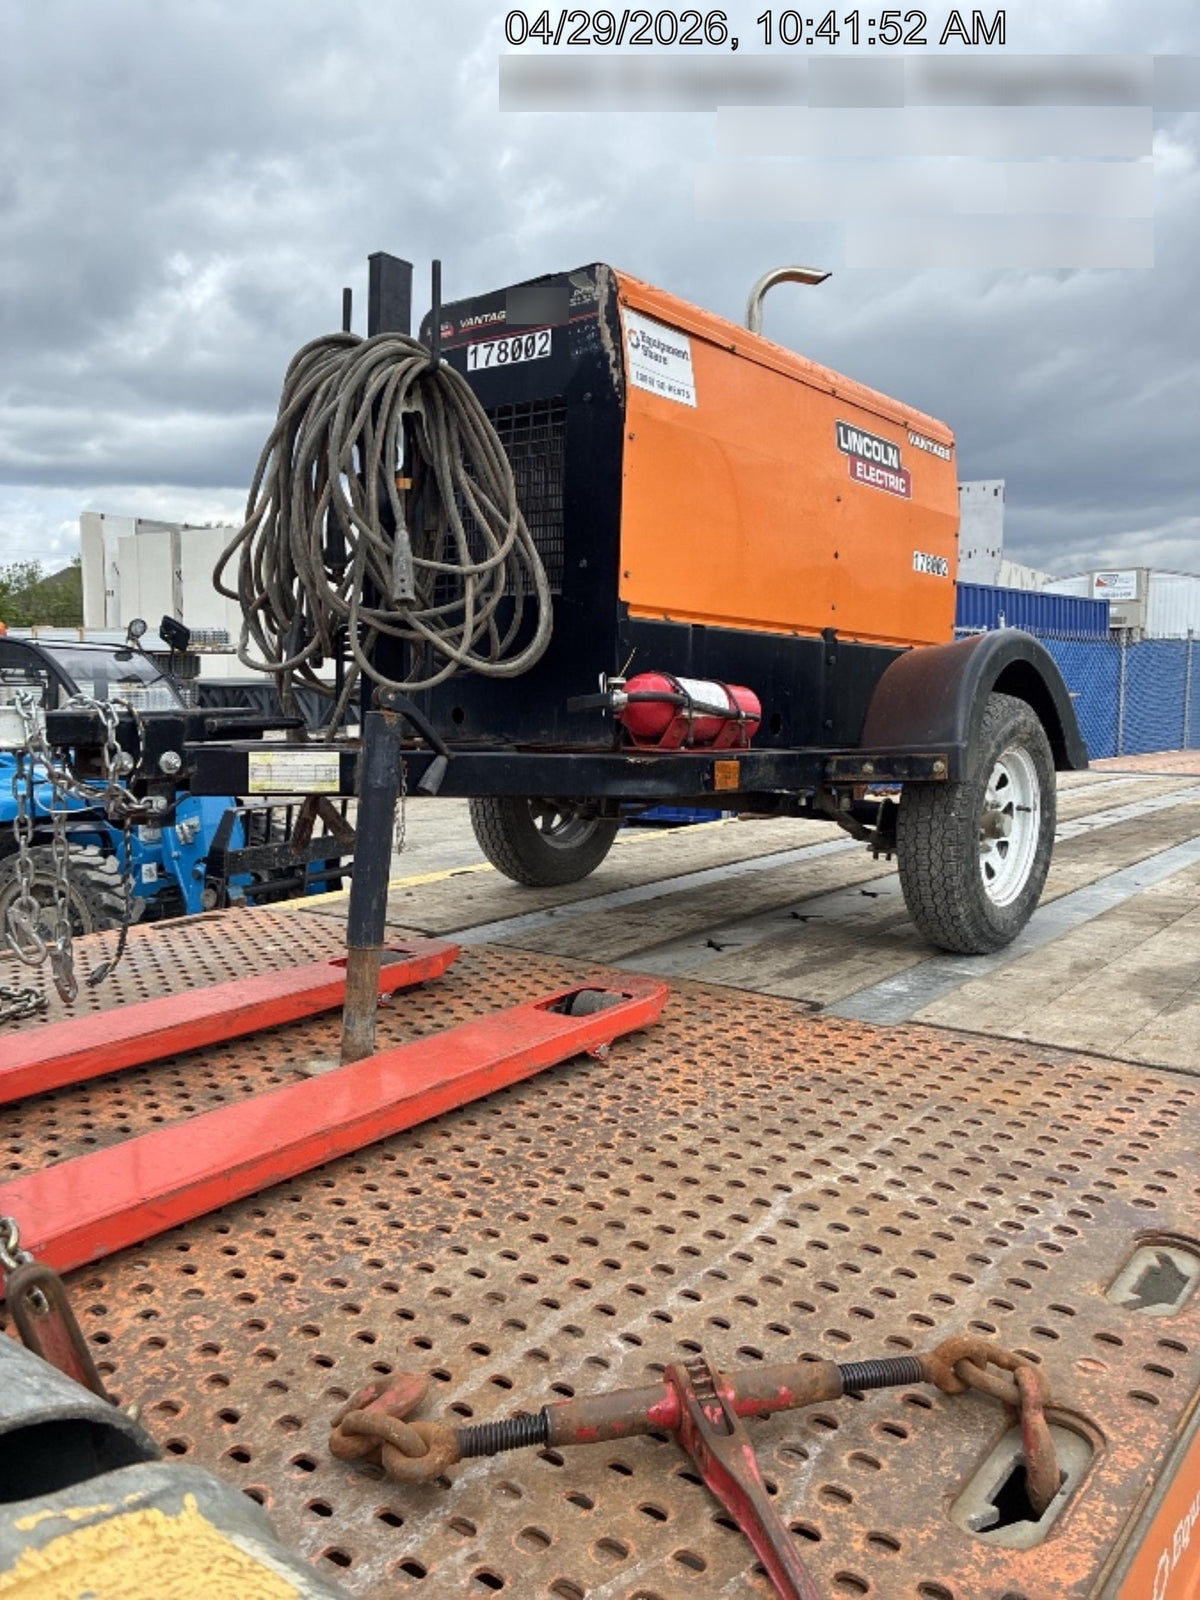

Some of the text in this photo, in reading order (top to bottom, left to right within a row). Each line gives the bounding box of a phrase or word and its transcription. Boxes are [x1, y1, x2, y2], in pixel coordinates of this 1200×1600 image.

[459, 310, 507, 327] VANTAG
[469, 332, 550, 369] 178002
[838, 426, 899, 469] LINCOLN
[908, 432, 949, 461] VANTAGE
[856, 461, 906, 493] ELECTRIC
